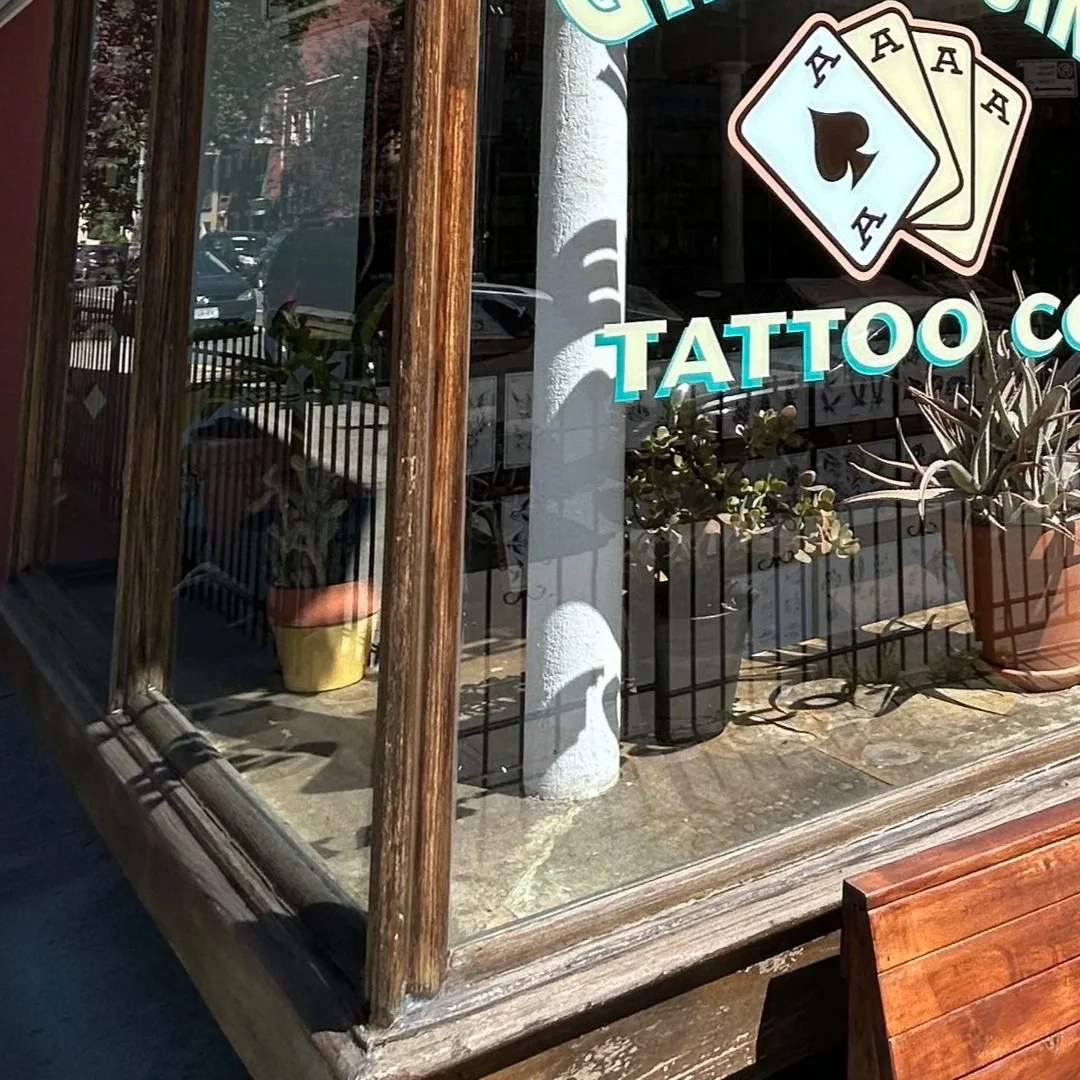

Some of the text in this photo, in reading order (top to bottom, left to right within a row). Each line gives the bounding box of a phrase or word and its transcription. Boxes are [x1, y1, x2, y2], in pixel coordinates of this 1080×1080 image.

[869, 27, 905, 63] A
[930, 46, 964, 75] A
[804, 45, 842, 89] A
[979, 88, 1011, 126] A
[850, 206, 888, 252] A
[595, 297, 983, 404] TATTOO
